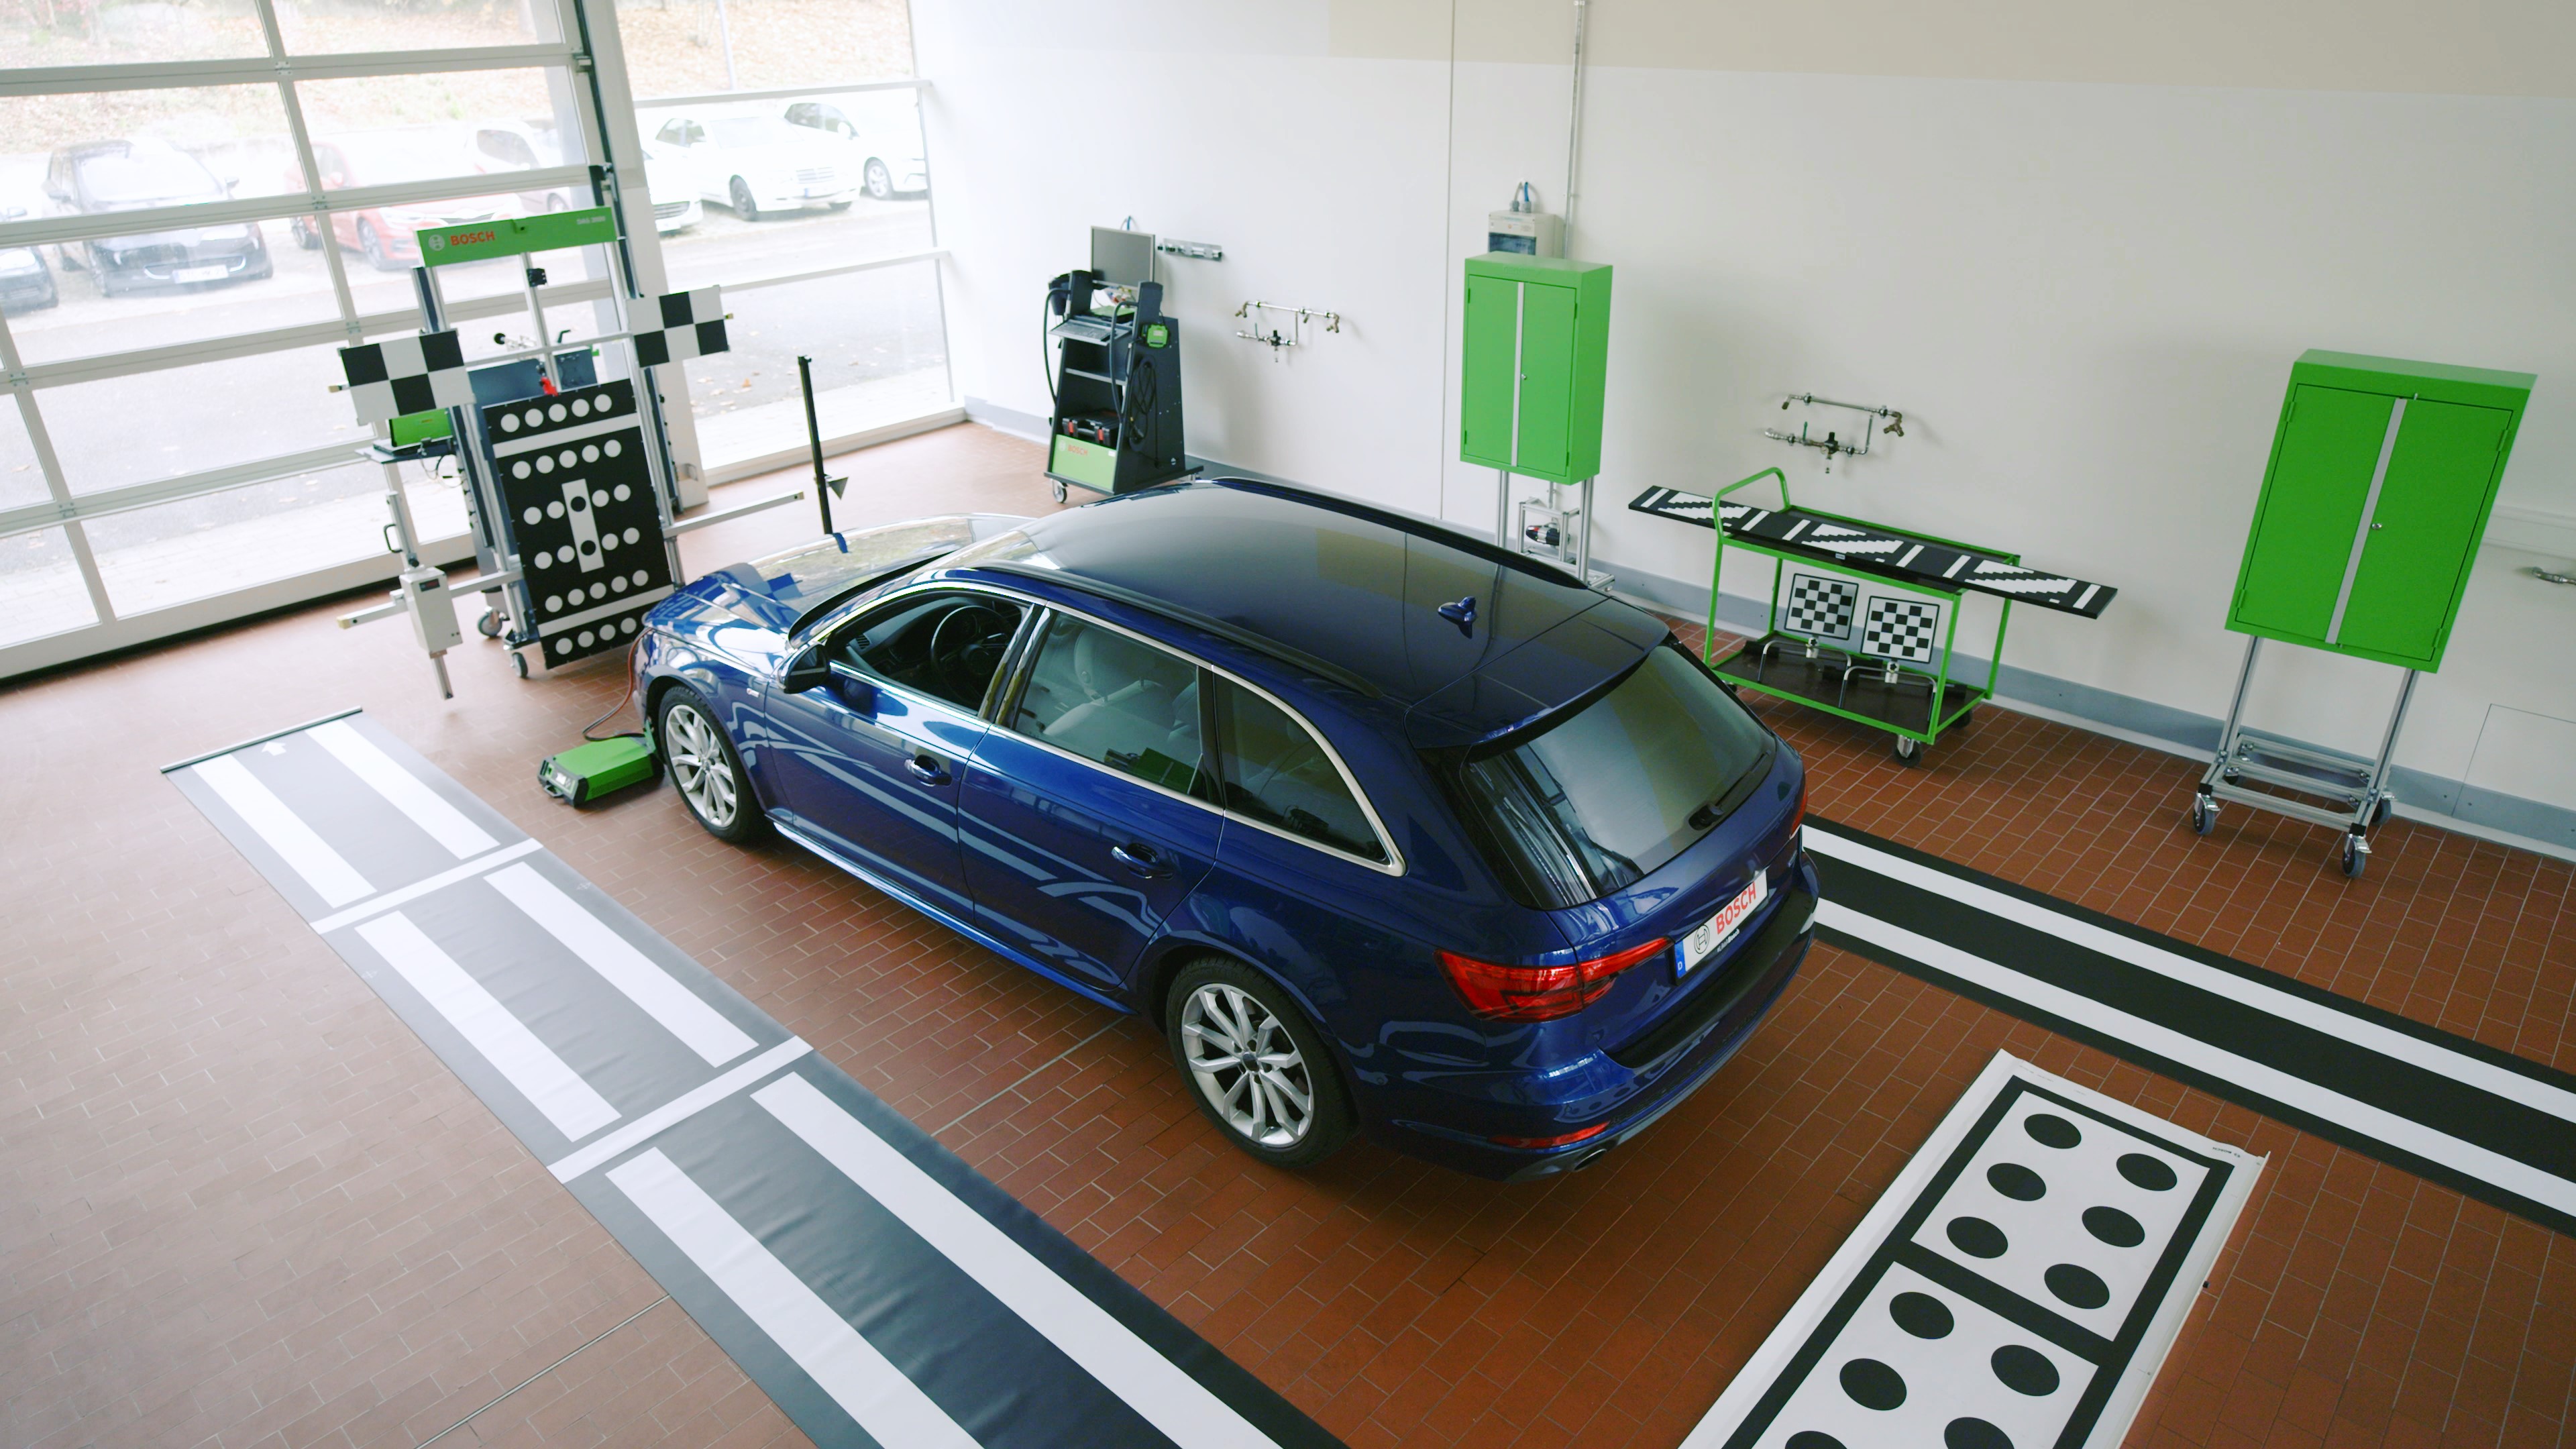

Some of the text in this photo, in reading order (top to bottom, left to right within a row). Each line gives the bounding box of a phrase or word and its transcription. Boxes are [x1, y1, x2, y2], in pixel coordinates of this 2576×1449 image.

[450, 231, 495, 246] BOSCH
[1068, 445, 1088, 455] BOSCH
[1716, 881, 1756, 934] BOSCH
[1677, 961, 1683, 971] D
